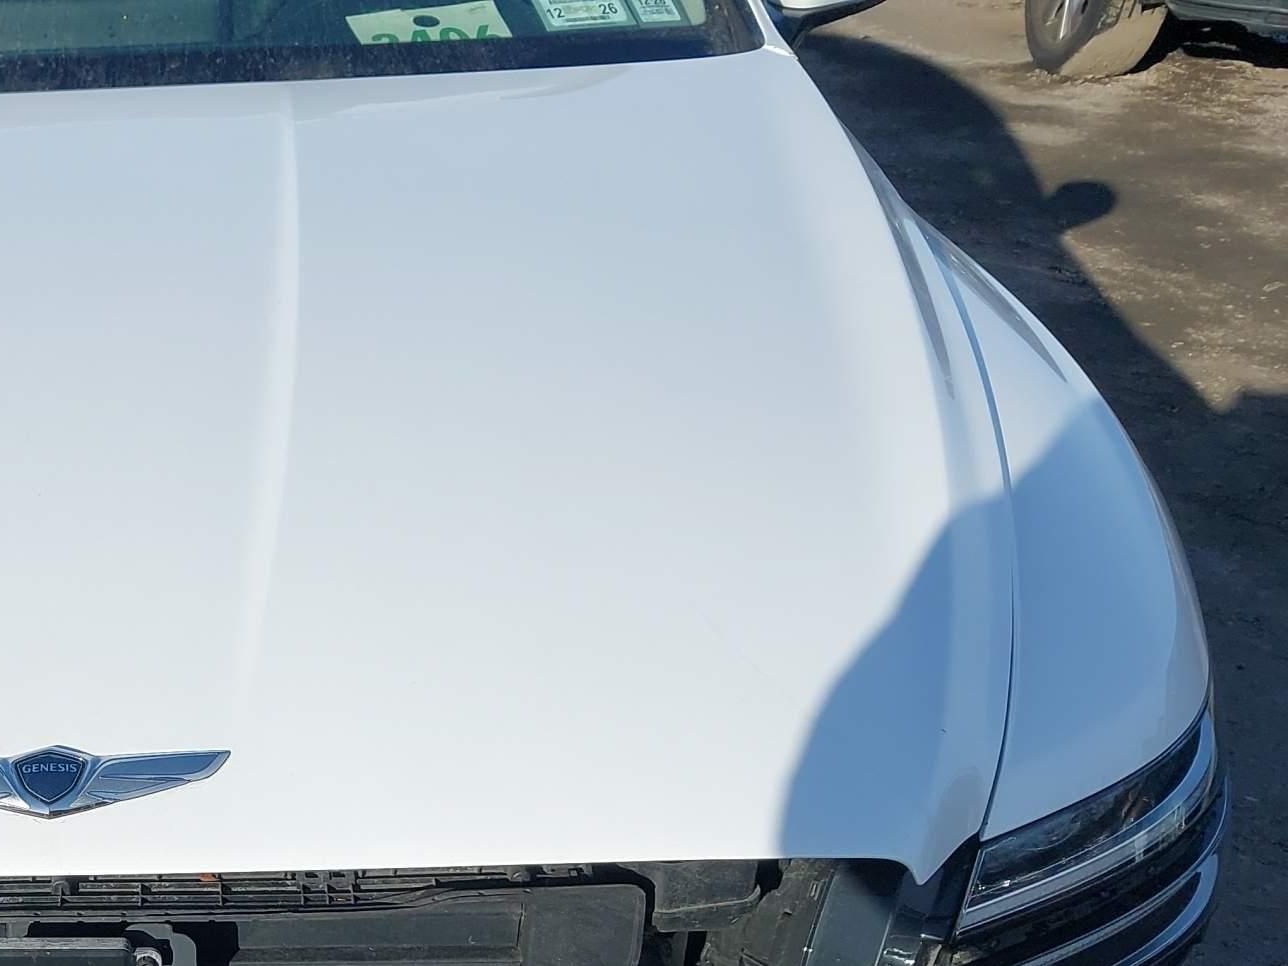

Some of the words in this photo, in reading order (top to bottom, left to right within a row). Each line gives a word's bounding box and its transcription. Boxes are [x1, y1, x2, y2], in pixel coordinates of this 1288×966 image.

[546, 7, 566, 19] 12
[598, 2, 618, 15] 26
[22, 762, 78, 774] GENESIS
